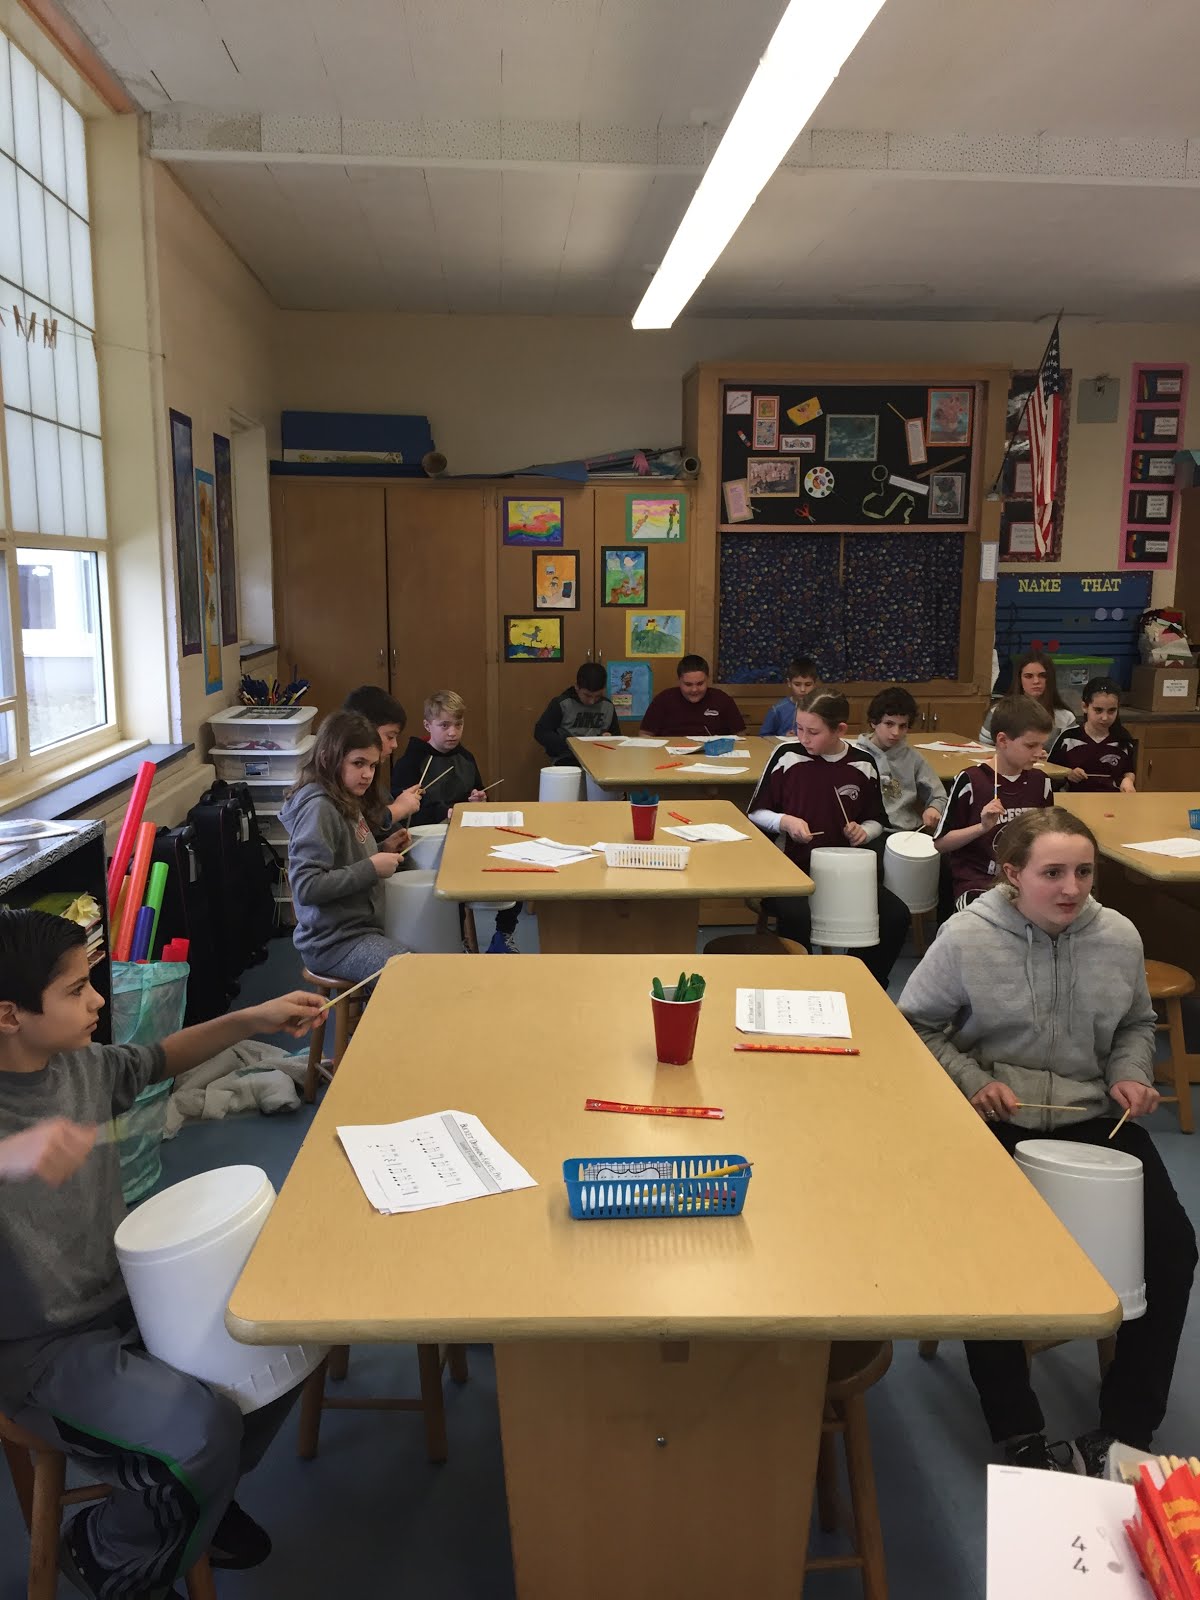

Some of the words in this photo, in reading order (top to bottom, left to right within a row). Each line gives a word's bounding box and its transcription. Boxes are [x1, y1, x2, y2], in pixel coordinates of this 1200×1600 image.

[1018, 579, 1061, 592] NAME
[1081, 578, 1122, 592] THAT
[572, 712, 604, 728] NIKE
[1071, 1535, 1087, 1551] 4
[1072, 1557, 1089, 1574] 4
